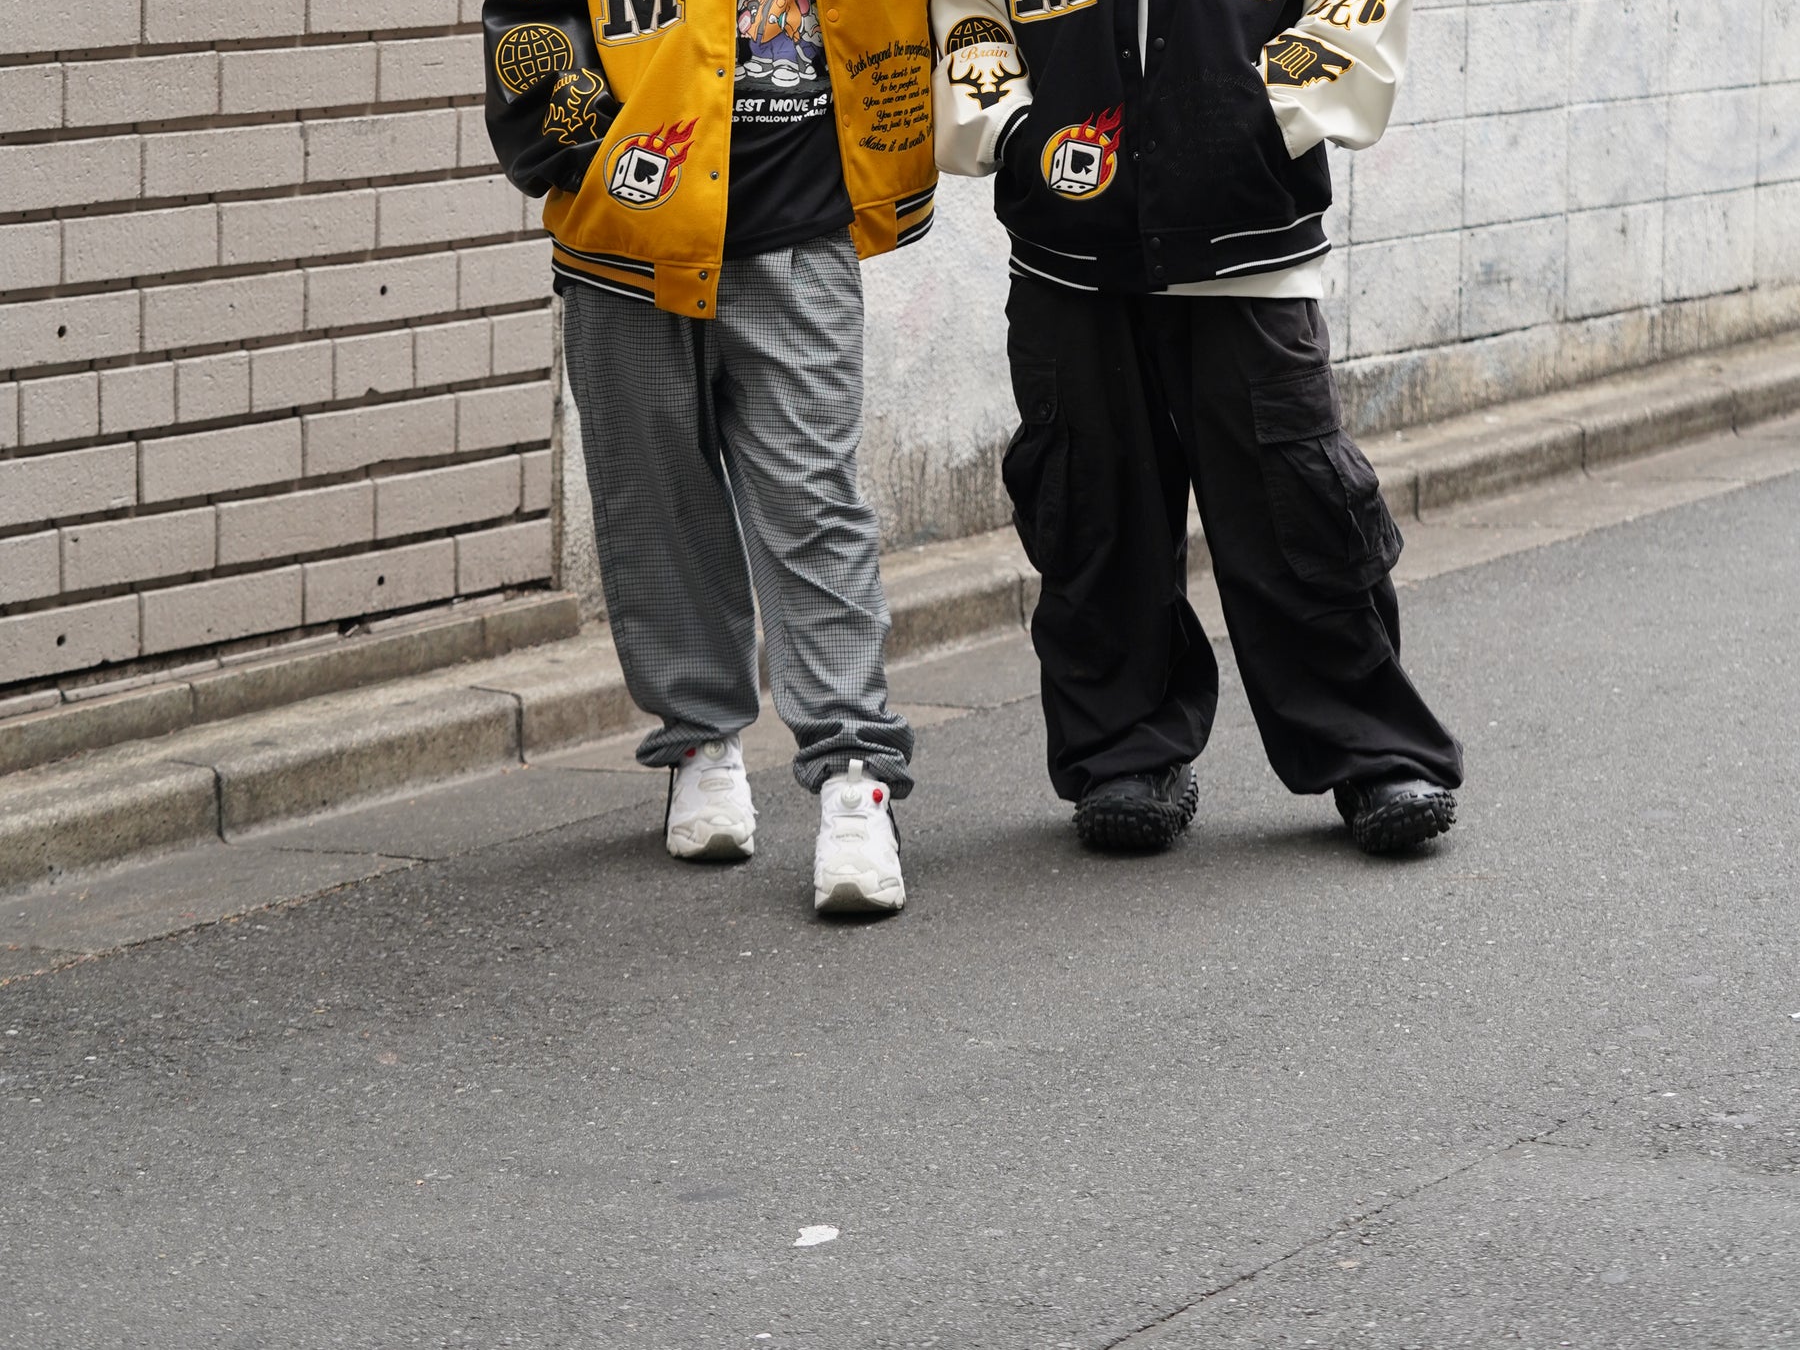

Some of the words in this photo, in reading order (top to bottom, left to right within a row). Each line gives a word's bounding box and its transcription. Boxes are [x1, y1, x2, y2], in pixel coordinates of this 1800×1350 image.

[866, 41, 892, 70] beyond
[894, 40, 904, 57] the
[960, 46, 1009, 63] Brain
[871, 71, 889, 86] You
[880, 82, 887, 92] to
[889, 82, 898, 91] be
[769, 98, 810, 112] MOVE
[813, 93, 828, 106] IS
[863, 96, 880, 111] You
[895, 94, 907, 102] one
[908, 87, 920, 99] and
[741, 115, 754, 123] TO
[756, 115, 789, 123] FOLLOW
[790, 114, 803, 123] MY
[876, 109, 892, 123] You
[904, 117, 911, 128] by
[859, 134, 887, 152] Makes
[888, 139, 897, 152] it
[898, 137, 909, 151] all
